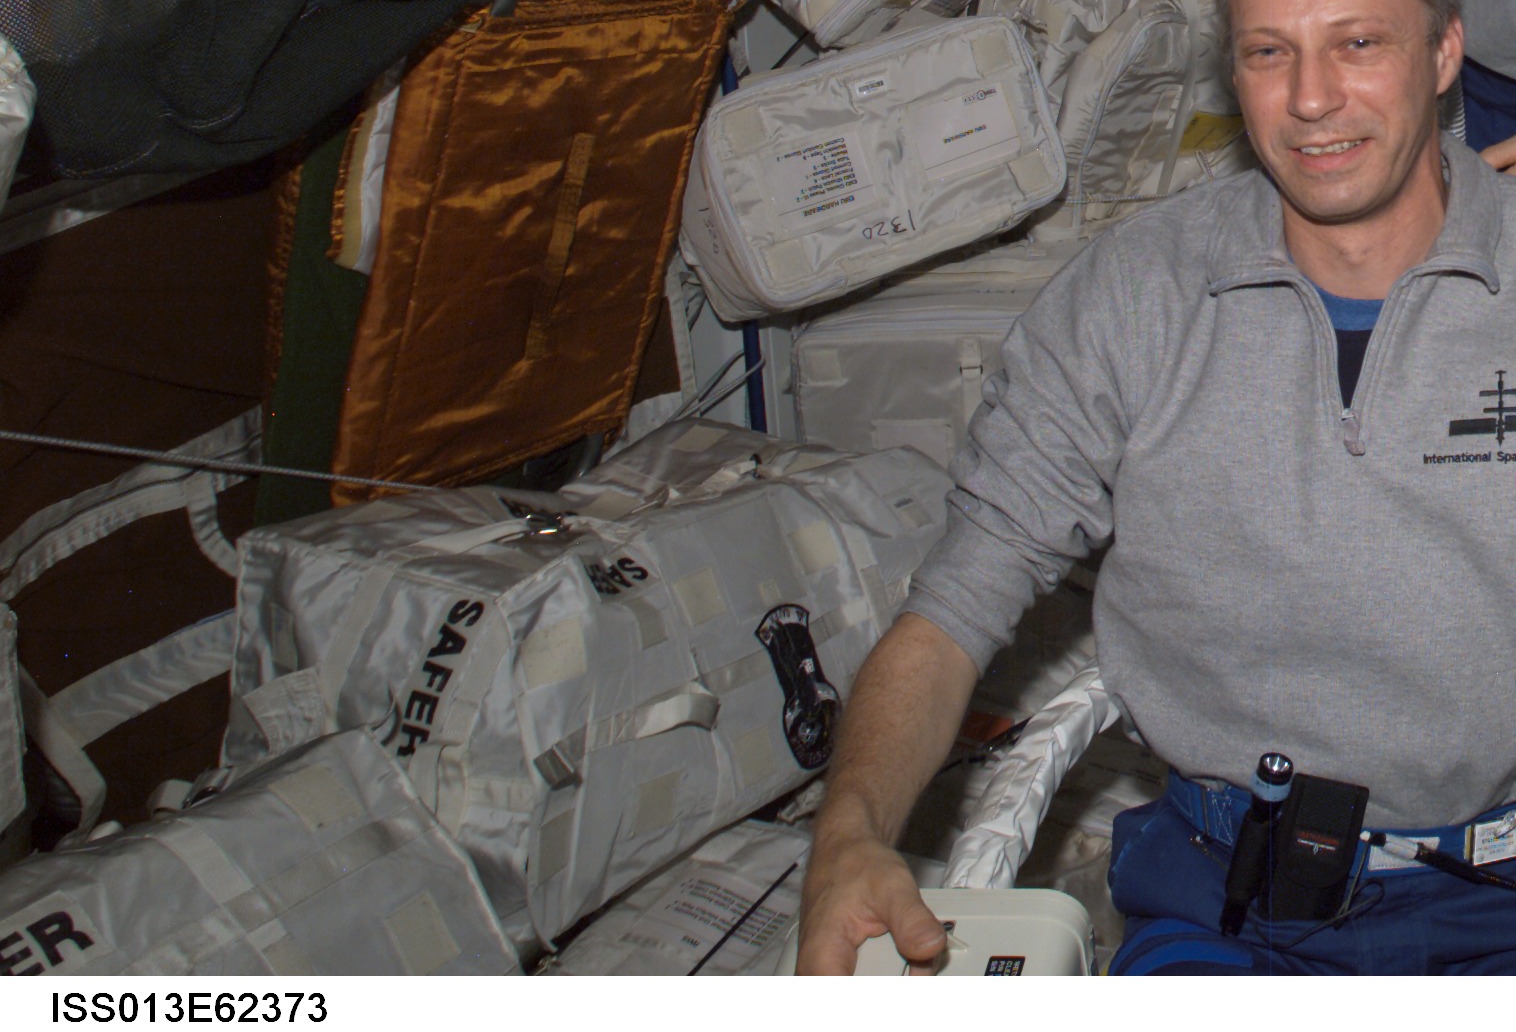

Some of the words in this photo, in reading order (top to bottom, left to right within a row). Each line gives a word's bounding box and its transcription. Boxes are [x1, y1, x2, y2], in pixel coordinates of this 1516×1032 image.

[862, 210, 916, 239] 1320
[1423, 450, 1492, 464] International
[396, 599, 486, 757] SAFER
